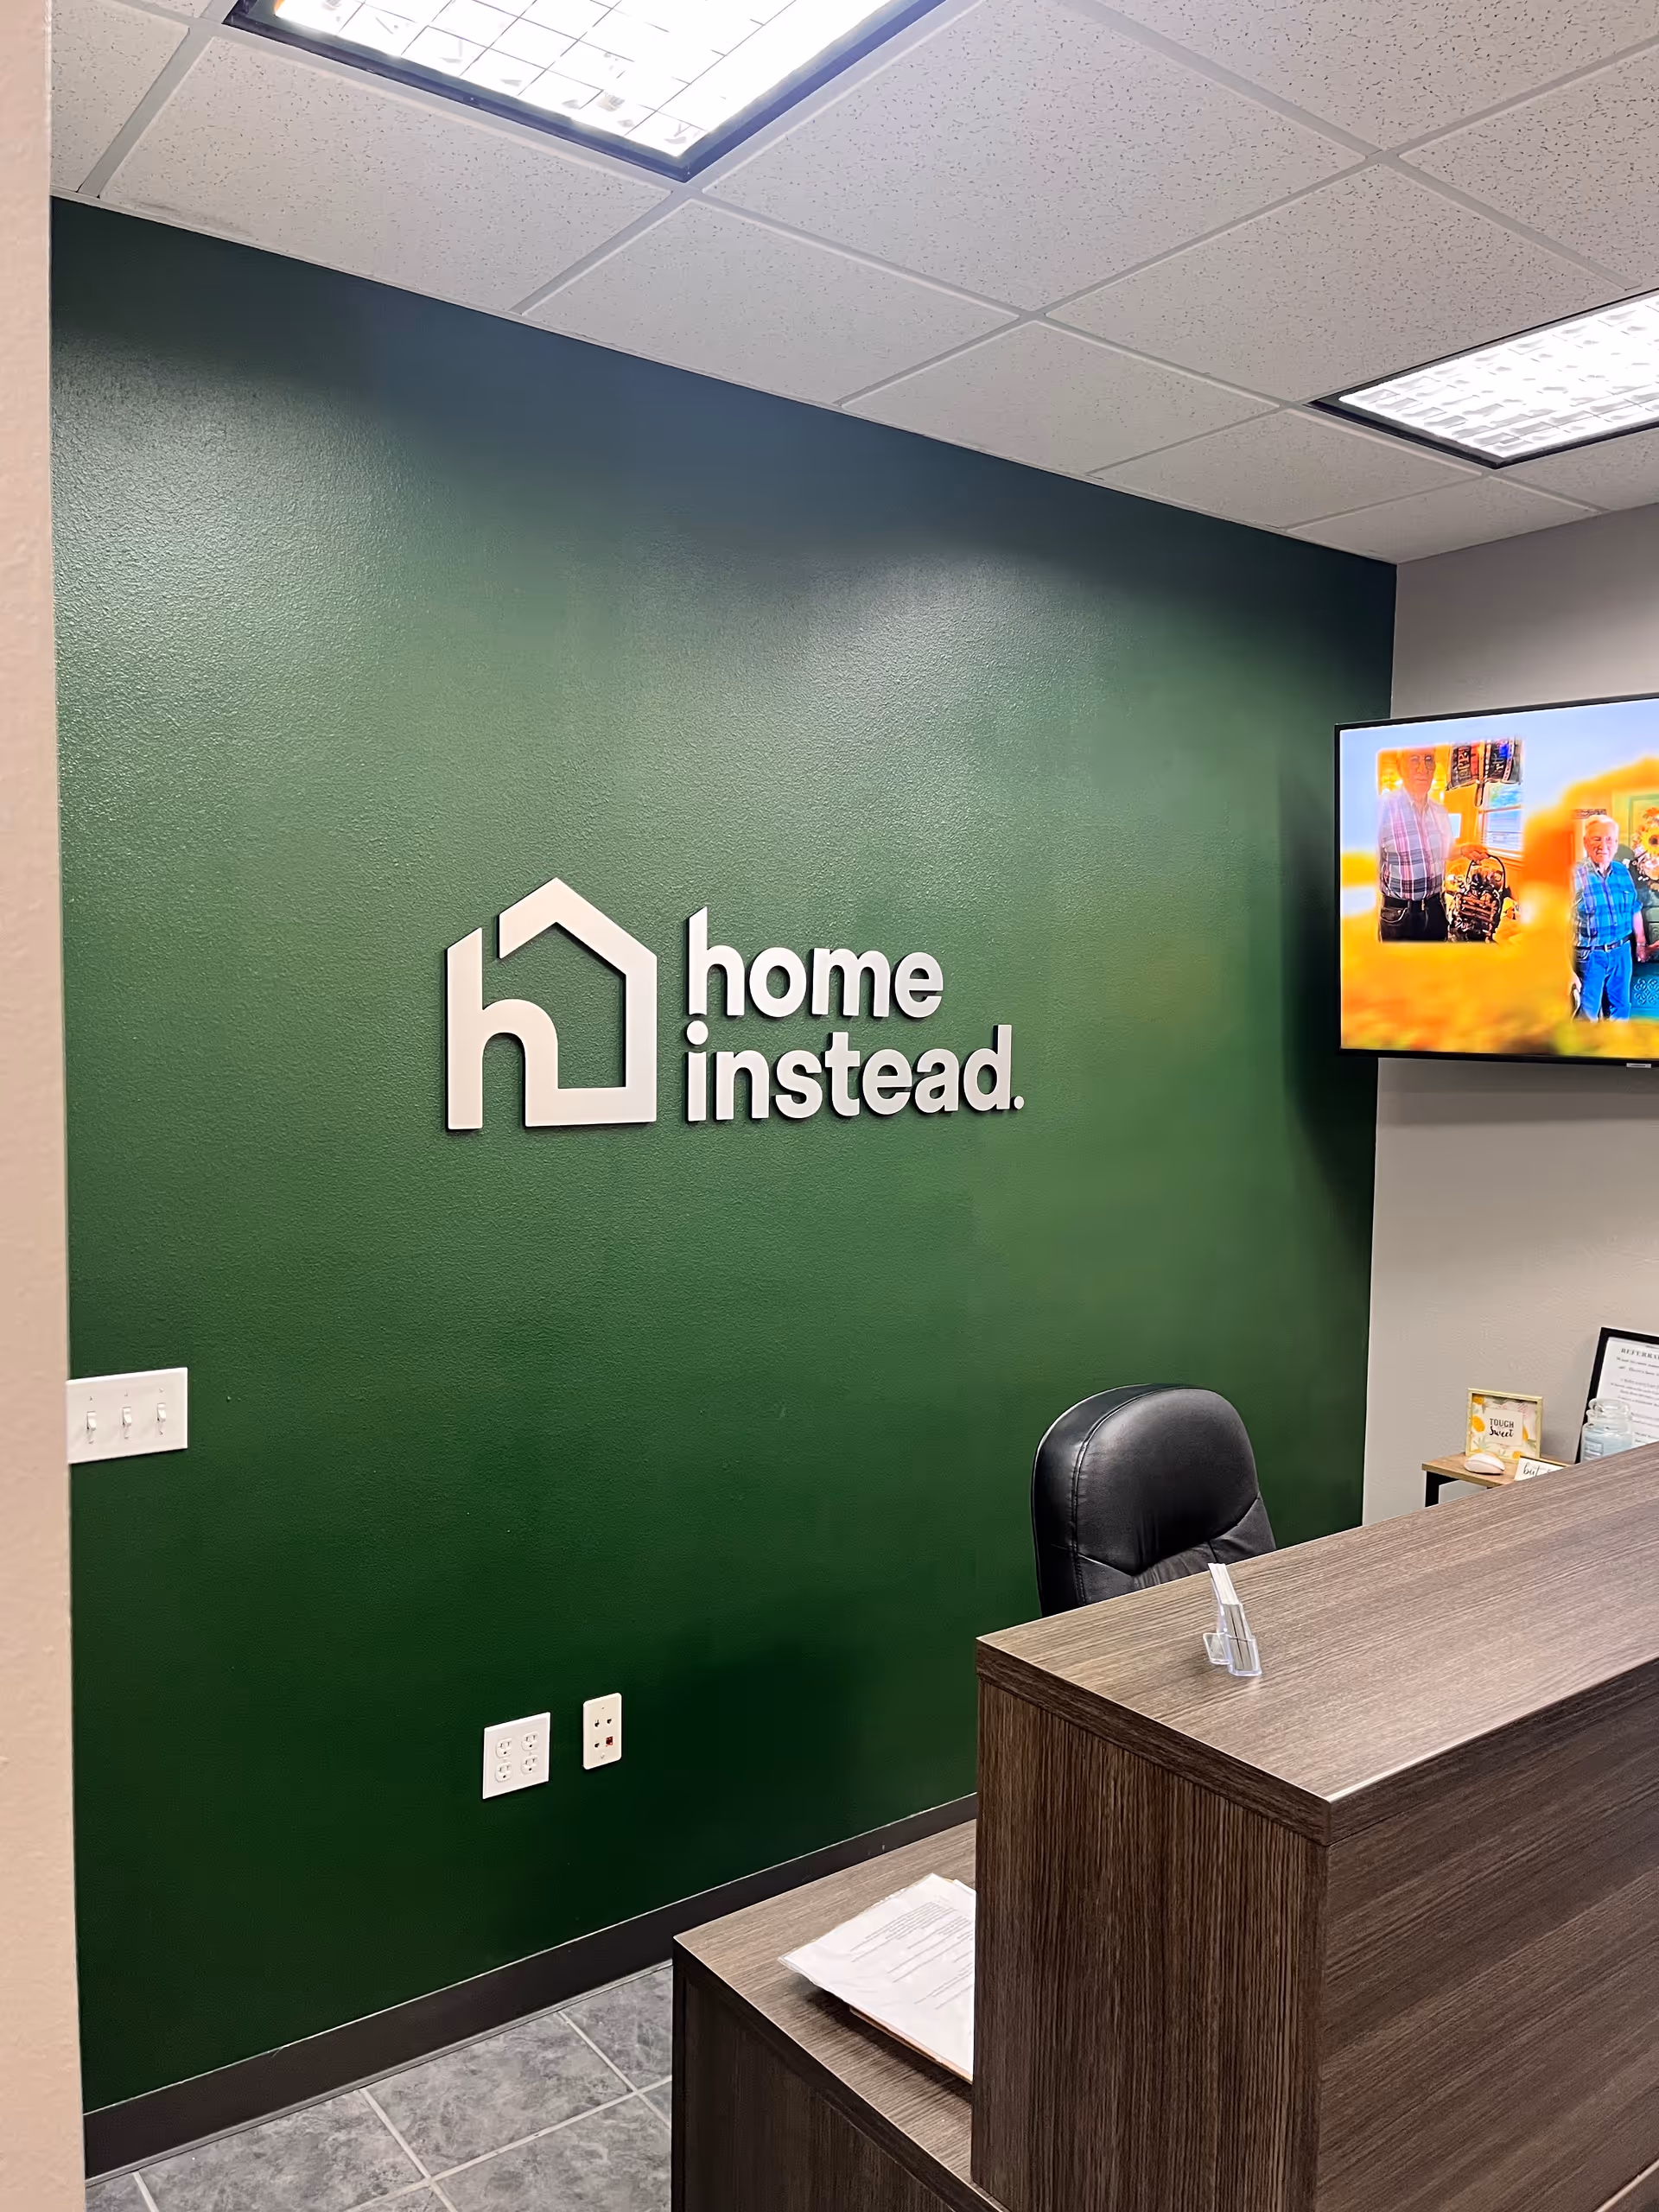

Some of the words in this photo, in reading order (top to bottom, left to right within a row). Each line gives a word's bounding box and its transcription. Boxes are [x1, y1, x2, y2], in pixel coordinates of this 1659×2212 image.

[688, 906, 944, 1018] home
[686, 1020, 1026, 1122] instead.
[1489, 1418, 1515, 1428] TOUGH
[1489, 1426, 1514, 1438] Sweet
